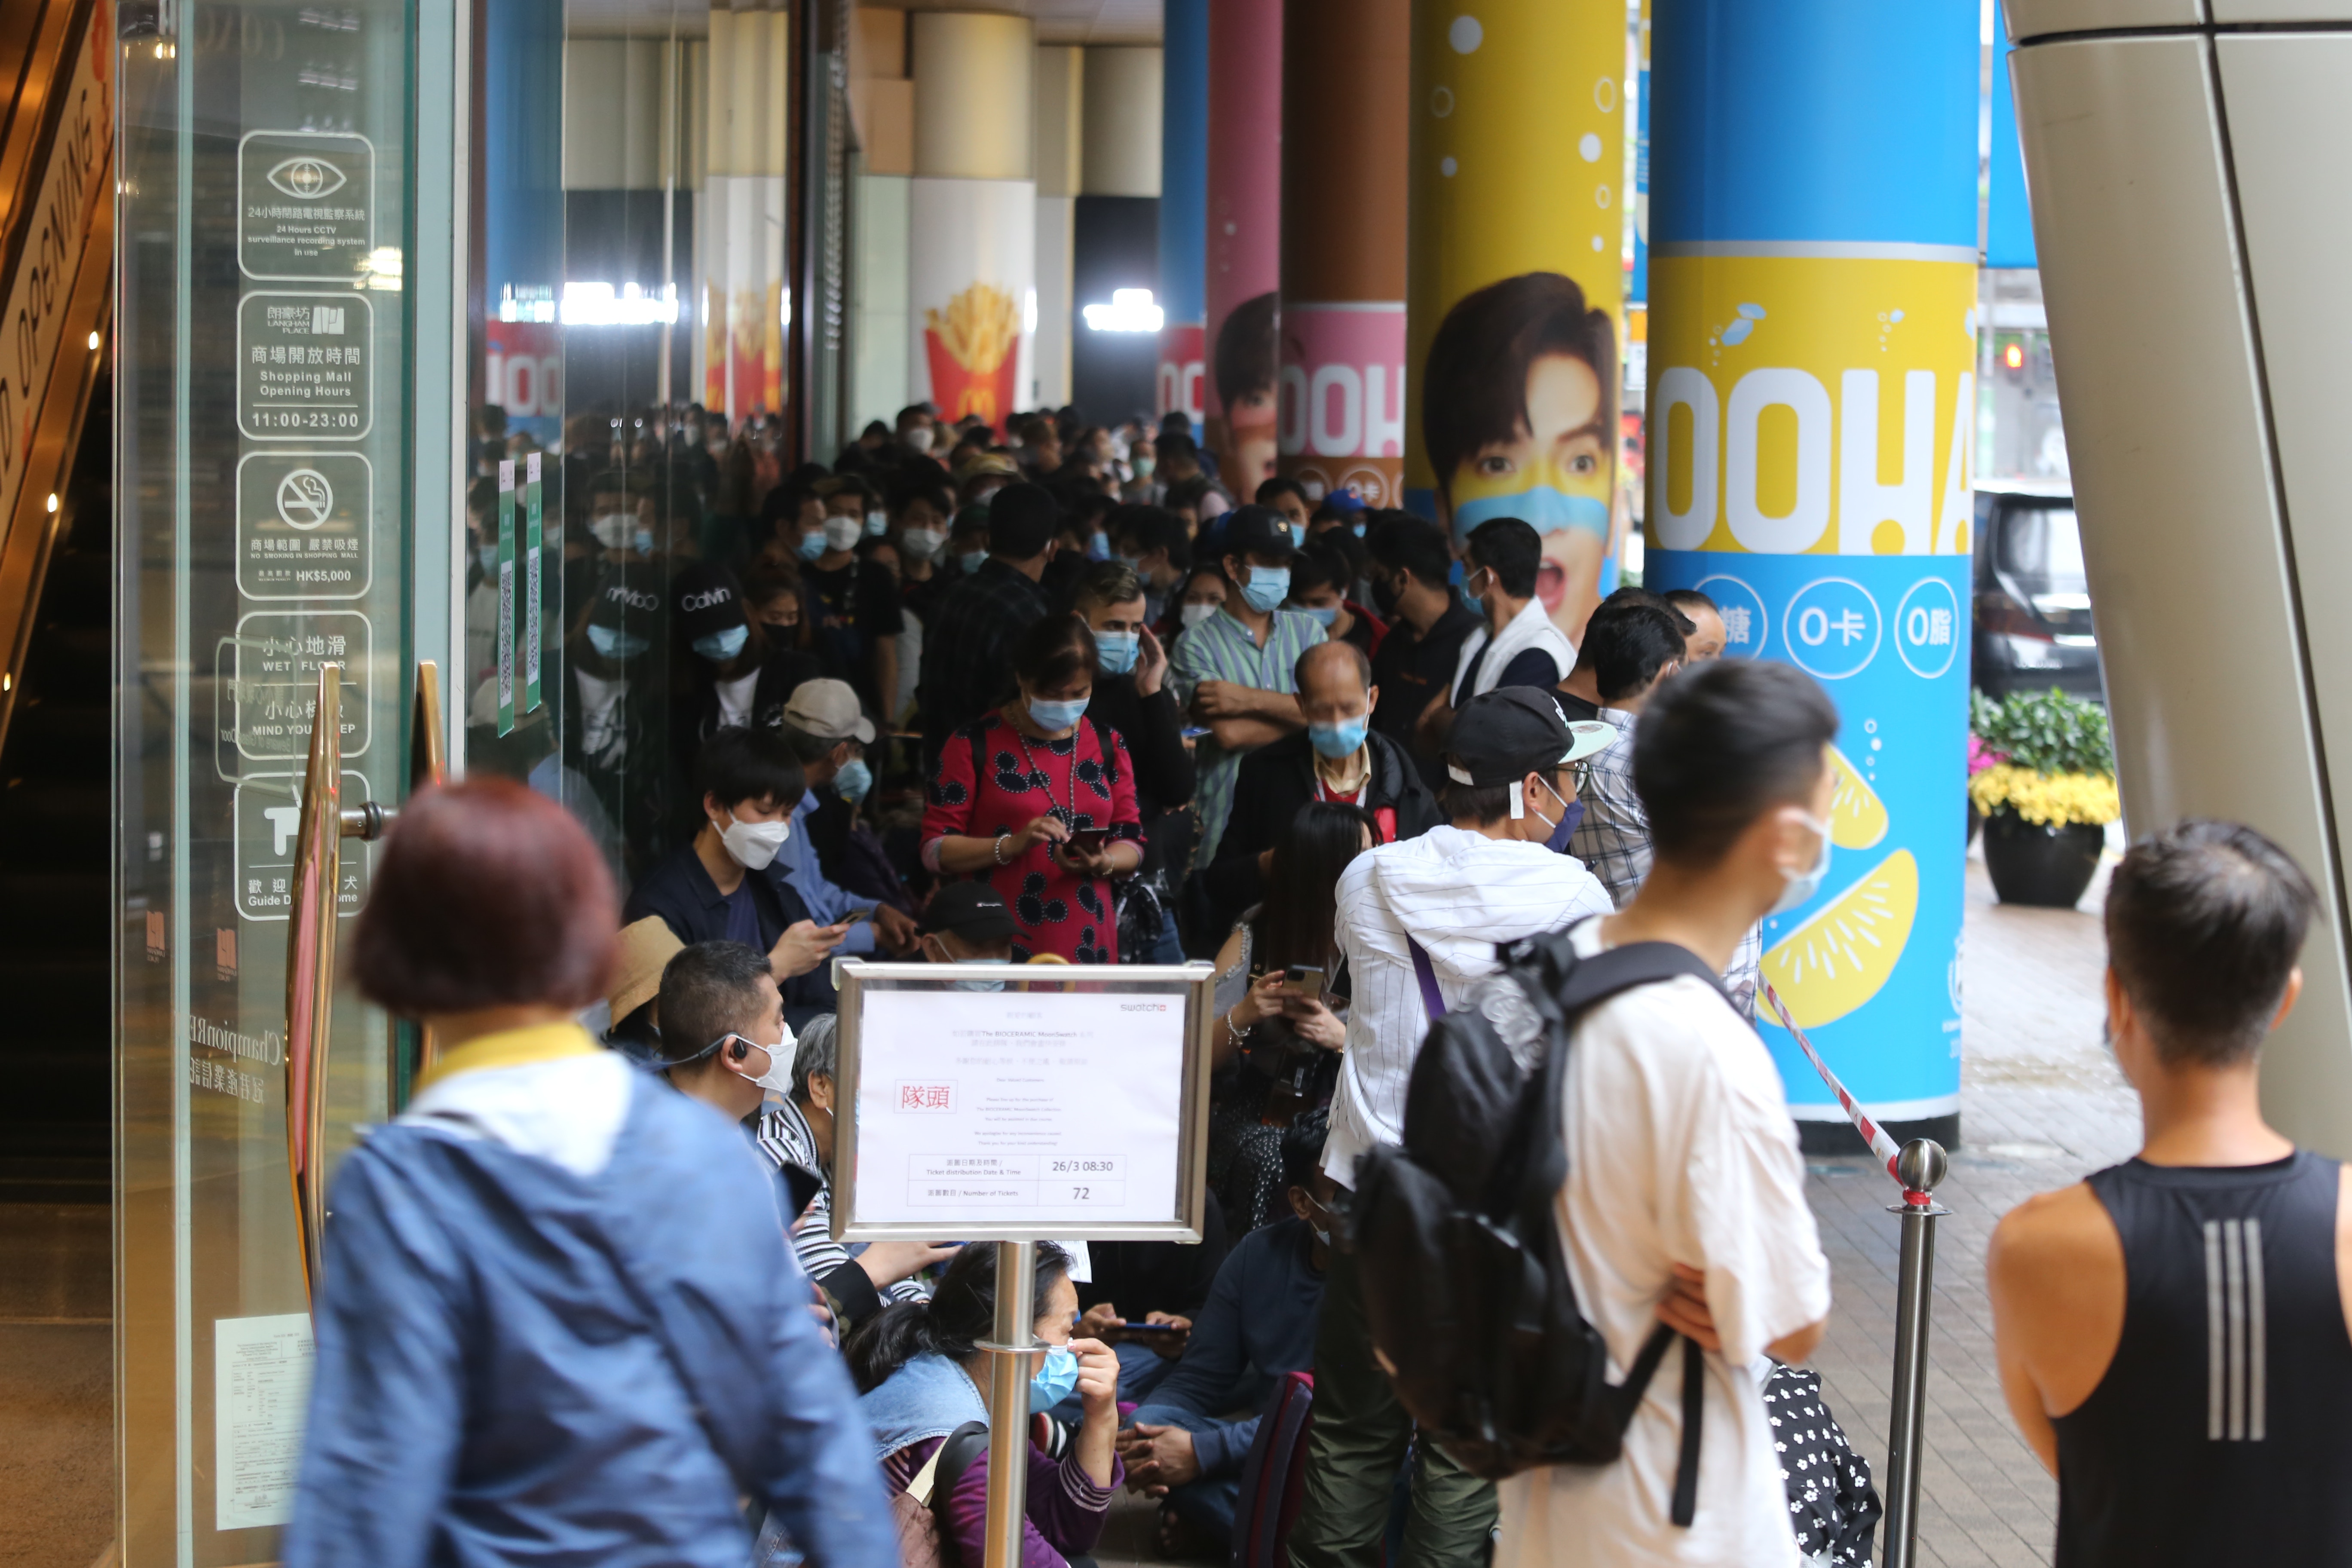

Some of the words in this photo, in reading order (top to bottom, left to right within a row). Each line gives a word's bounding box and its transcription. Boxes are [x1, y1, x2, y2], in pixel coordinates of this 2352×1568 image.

[297, 237, 335, 246] recording
[337, 238, 365, 246] system
[267, 307, 309, 320] 朗豪坊
[252, 346, 360, 365] 商場開放時間
[260, 371, 321, 384] Shopping
[326, 372, 352, 382] Mall
[260, 386, 311, 398] Opening
[315, 386, 351, 396] Hours
[252, 413, 358, 428] 11:00-23:00
[251, 539, 300, 551] 商場範圍
[309, 539, 358, 551] 嚴禁吸煙
[297, 570, 352, 583] HK$5,000
[263, 635, 346, 657] 小心地滑
[263, 661, 291, 671] WET
[252, 725, 283, 736] MIND
[248, 895, 281, 906] Guide
[901, 1085, 950, 1110] 隊頭
[1052, 1160, 1080, 1173] 26/3
[1083, 1161, 1113, 1172] 08:30
[1073, 1187, 1090, 1200] 72
